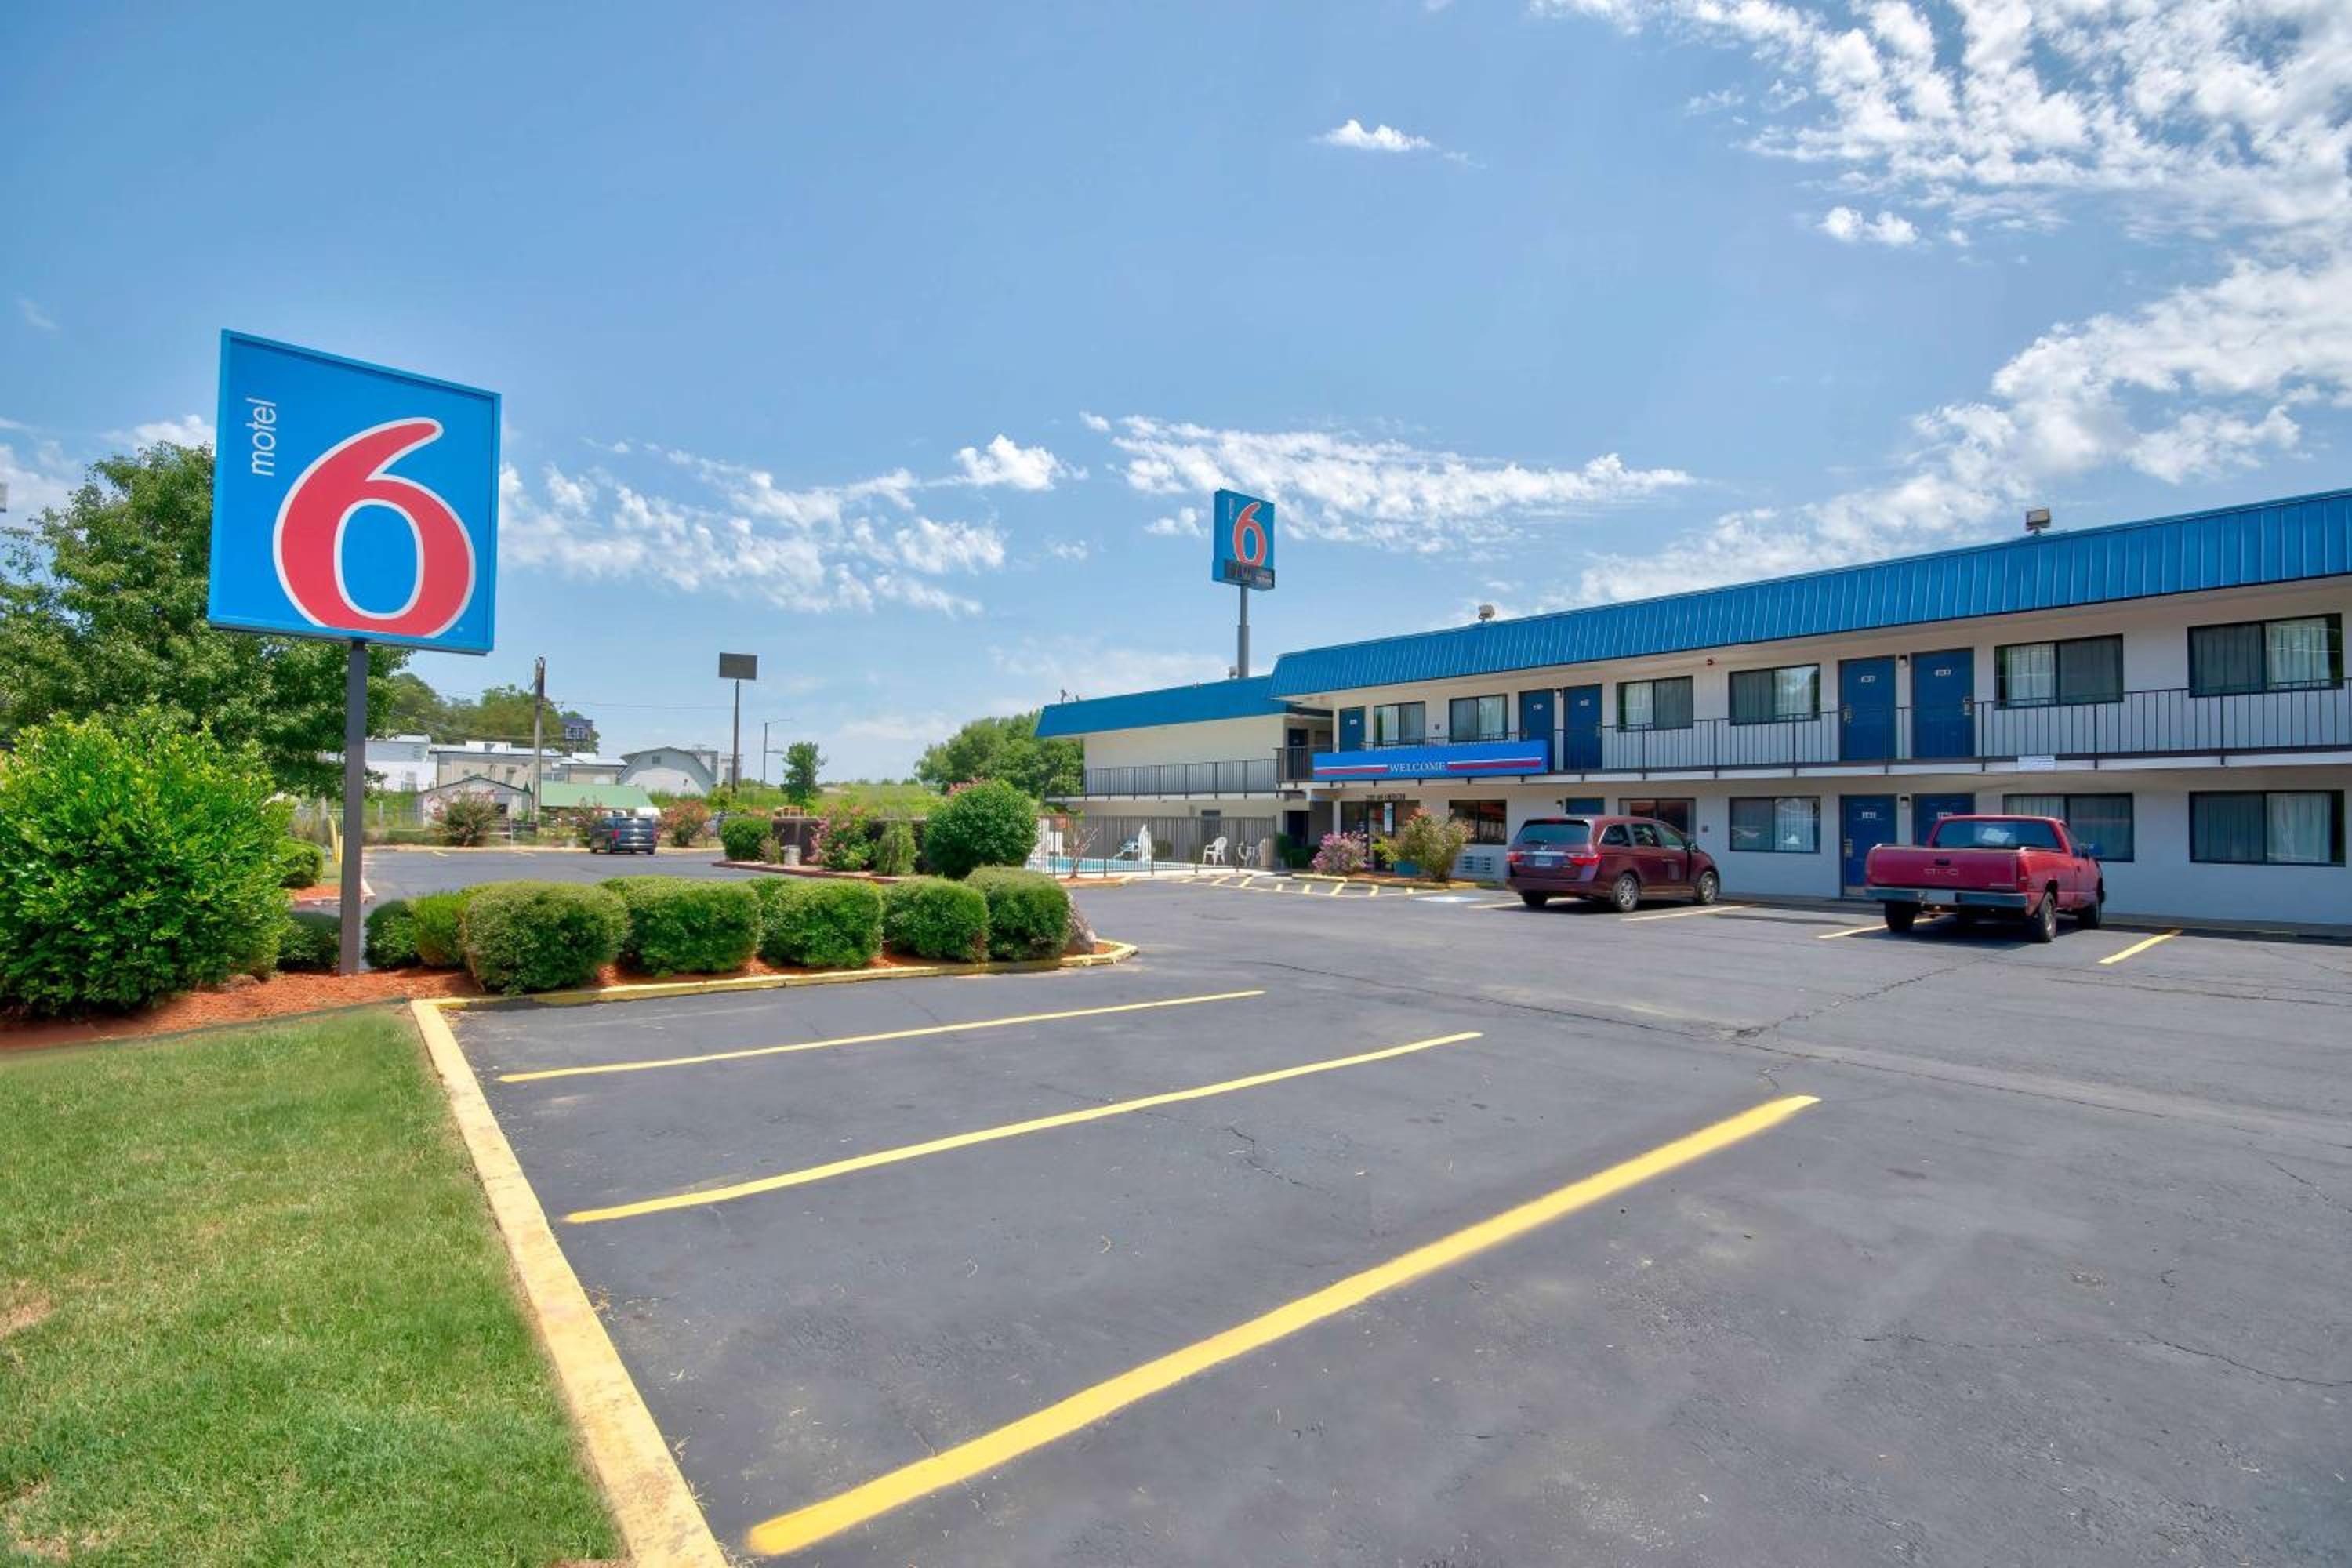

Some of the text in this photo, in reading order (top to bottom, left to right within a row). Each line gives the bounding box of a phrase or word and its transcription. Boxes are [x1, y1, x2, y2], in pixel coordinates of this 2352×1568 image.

[246, 397, 277, 477] motel
[272, 416, 476, 639] 6
[1233, 502, 1267, 566] 6
[1389, 761, 1446, 773] WELCOME
